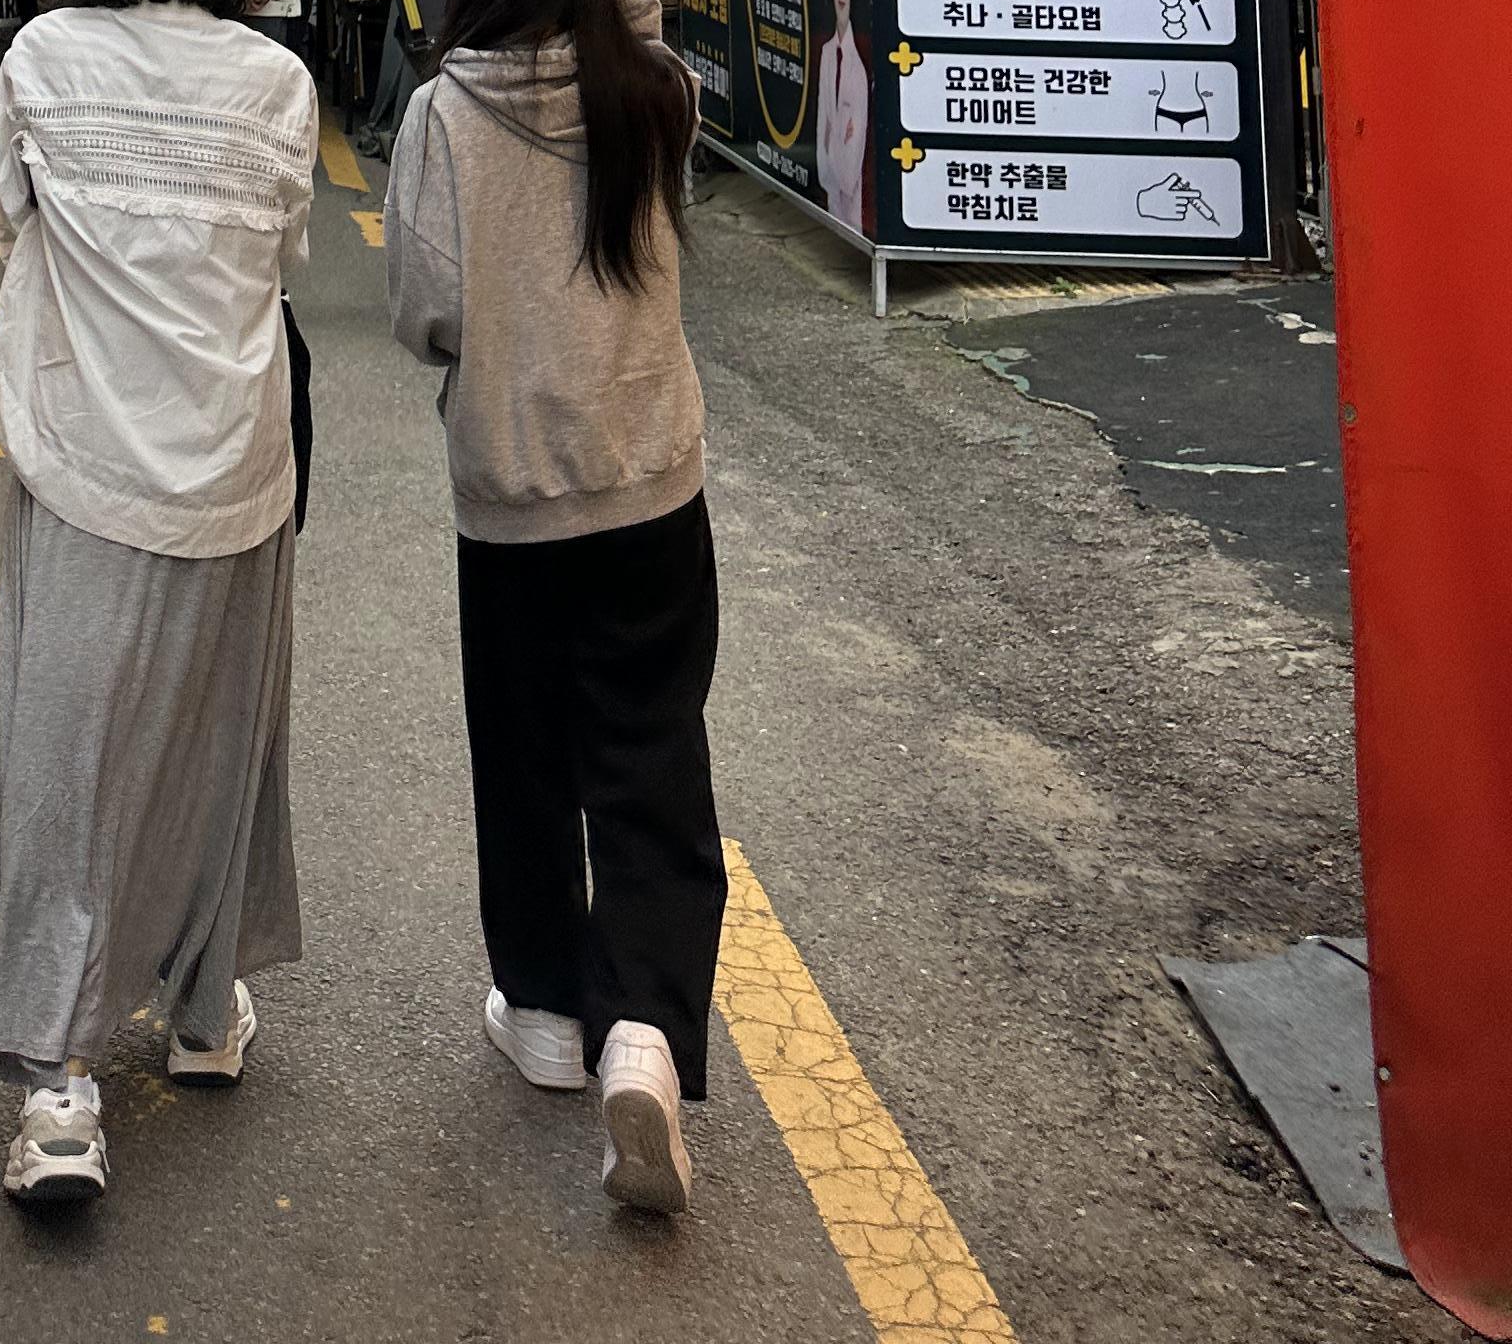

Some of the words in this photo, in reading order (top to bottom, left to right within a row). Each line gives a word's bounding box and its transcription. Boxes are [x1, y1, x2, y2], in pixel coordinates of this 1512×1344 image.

[942, 1, 989, 28] 추나
[1011, 4, 1102, 31] 골타요법
[945, 66, 1036, 93] 요요없는
[1043, 69, 1112, 96] 건강한
[946, 98, 1037, 125] 다이어트
[946, 162, 993, 189] 한약
[999, 163, 1068, 191] 추출물
[947, 194, 1039, 222] 약침치료
